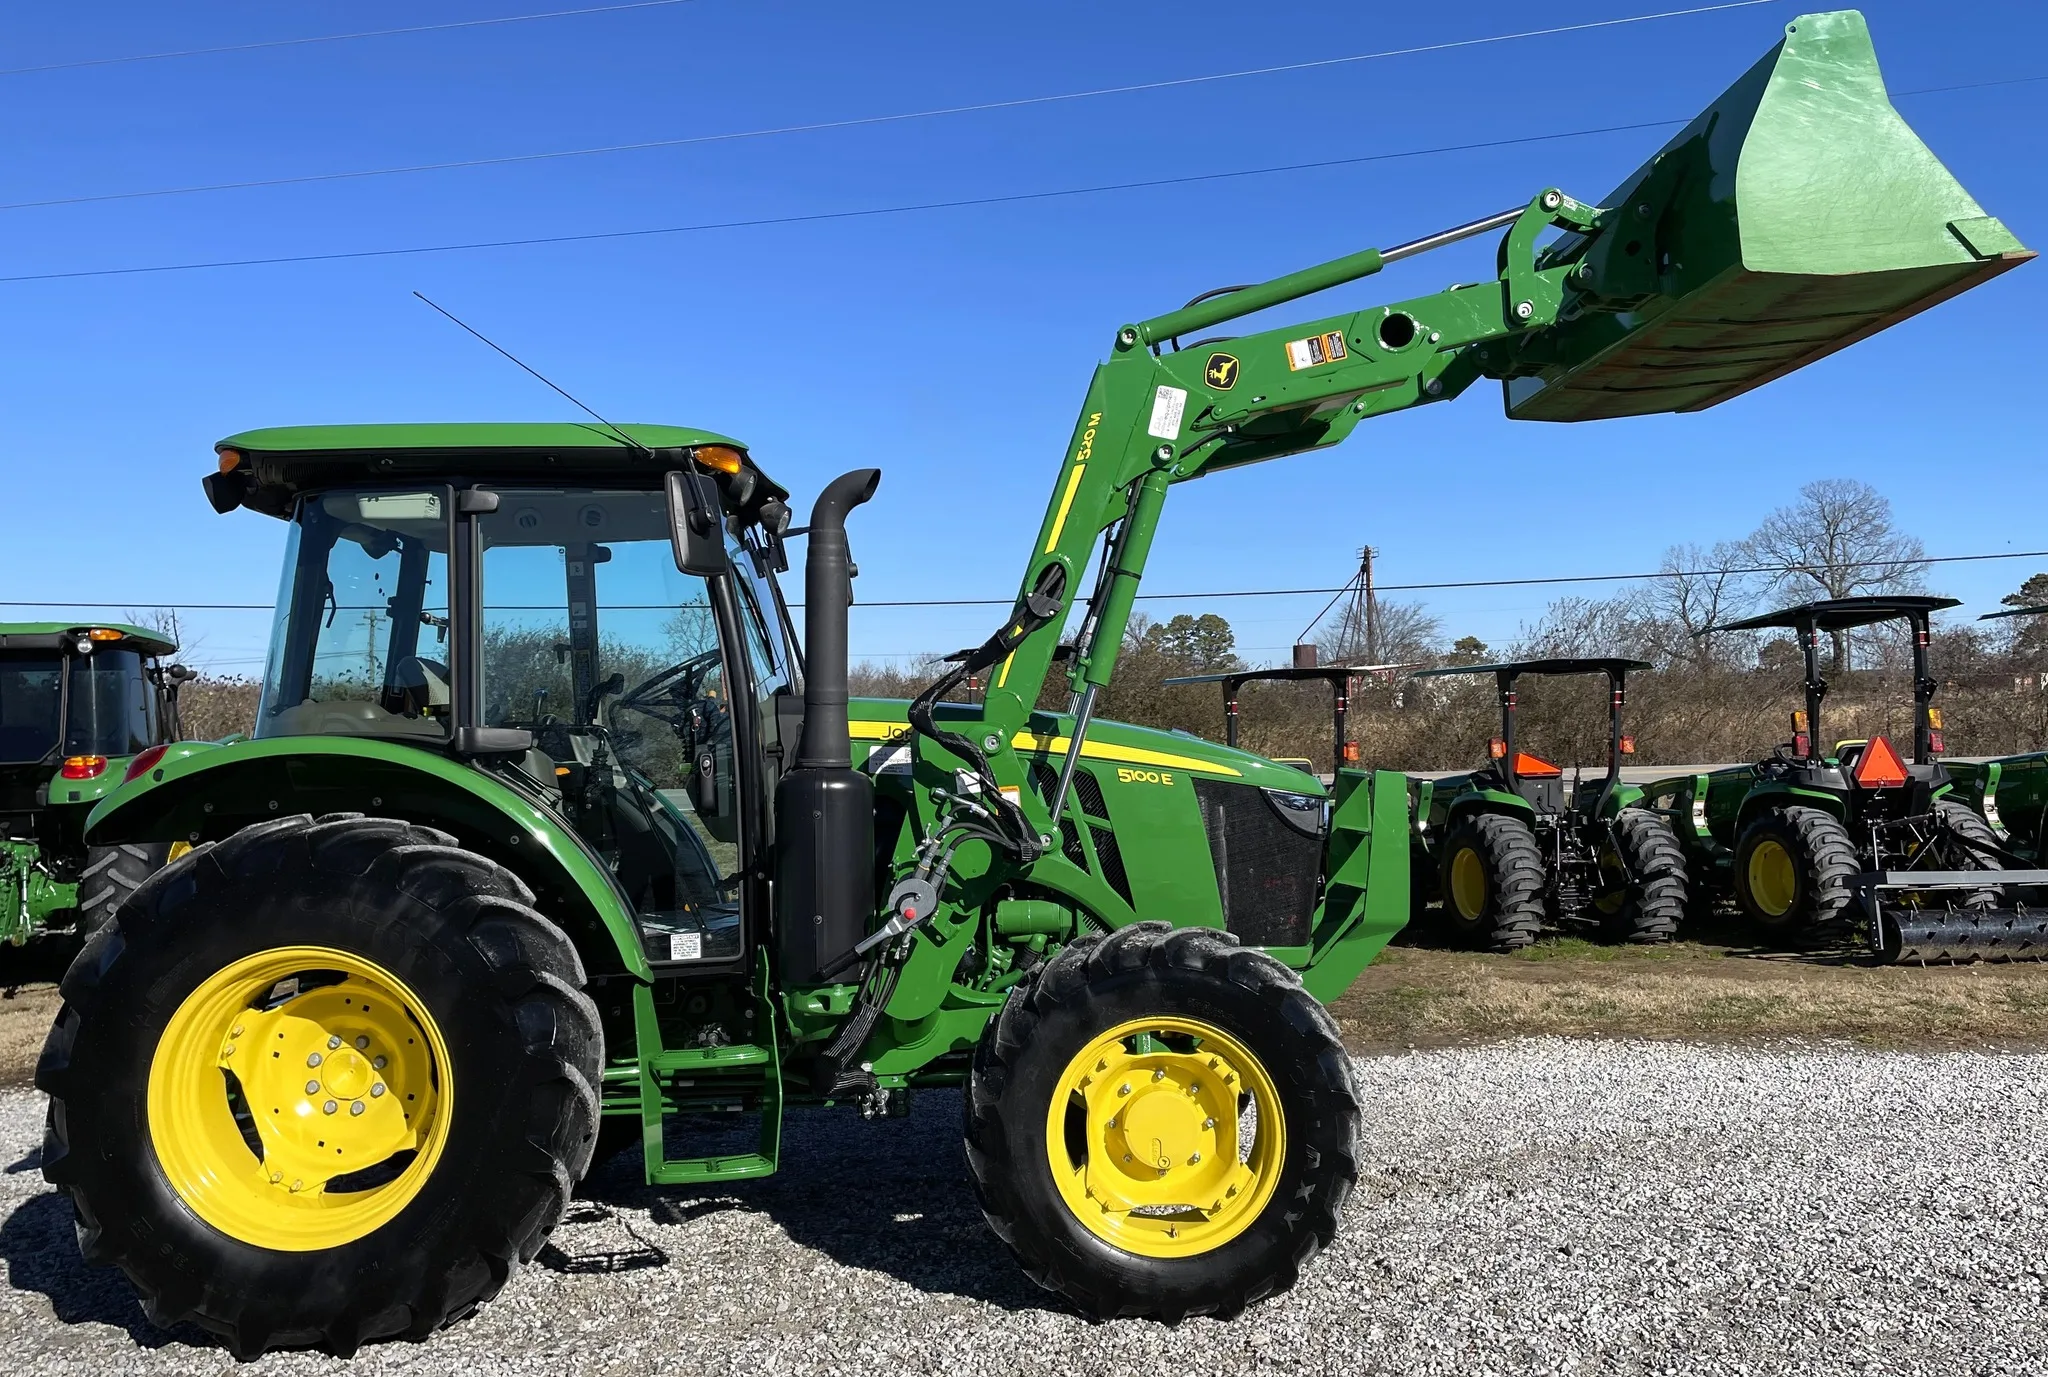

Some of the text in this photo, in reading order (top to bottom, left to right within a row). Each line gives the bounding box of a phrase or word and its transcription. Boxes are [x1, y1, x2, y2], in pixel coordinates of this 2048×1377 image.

[1076, 411, 1103, 462] 520 M
[1117, 767, 1174, 786] 5100 E
